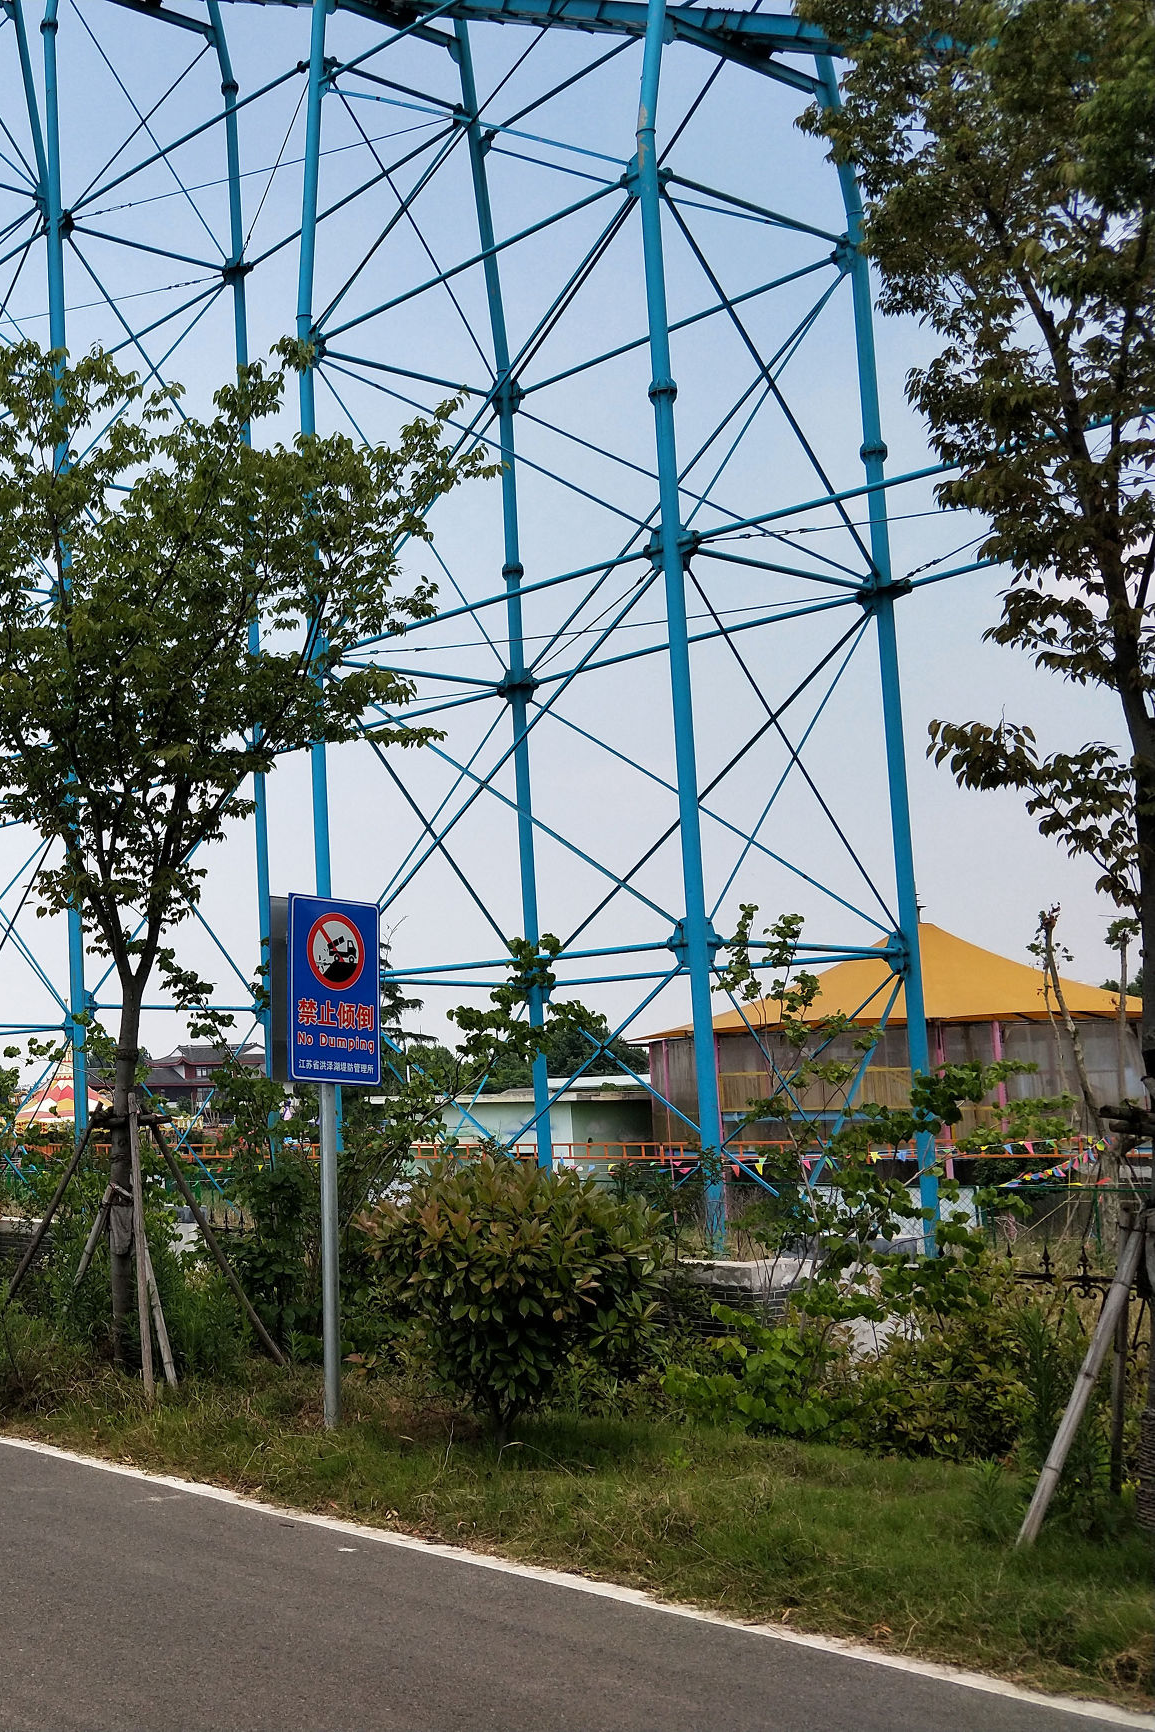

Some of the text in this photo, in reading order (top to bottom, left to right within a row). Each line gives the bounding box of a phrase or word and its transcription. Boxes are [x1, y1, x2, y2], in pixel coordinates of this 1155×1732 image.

[298, 998, 375, 1031] 禁止倾倒
[297, 1031, 375, 1055] No Dumping
[298, 1059, 374, 1075] 江苏省洪泽湖堤防管理所
